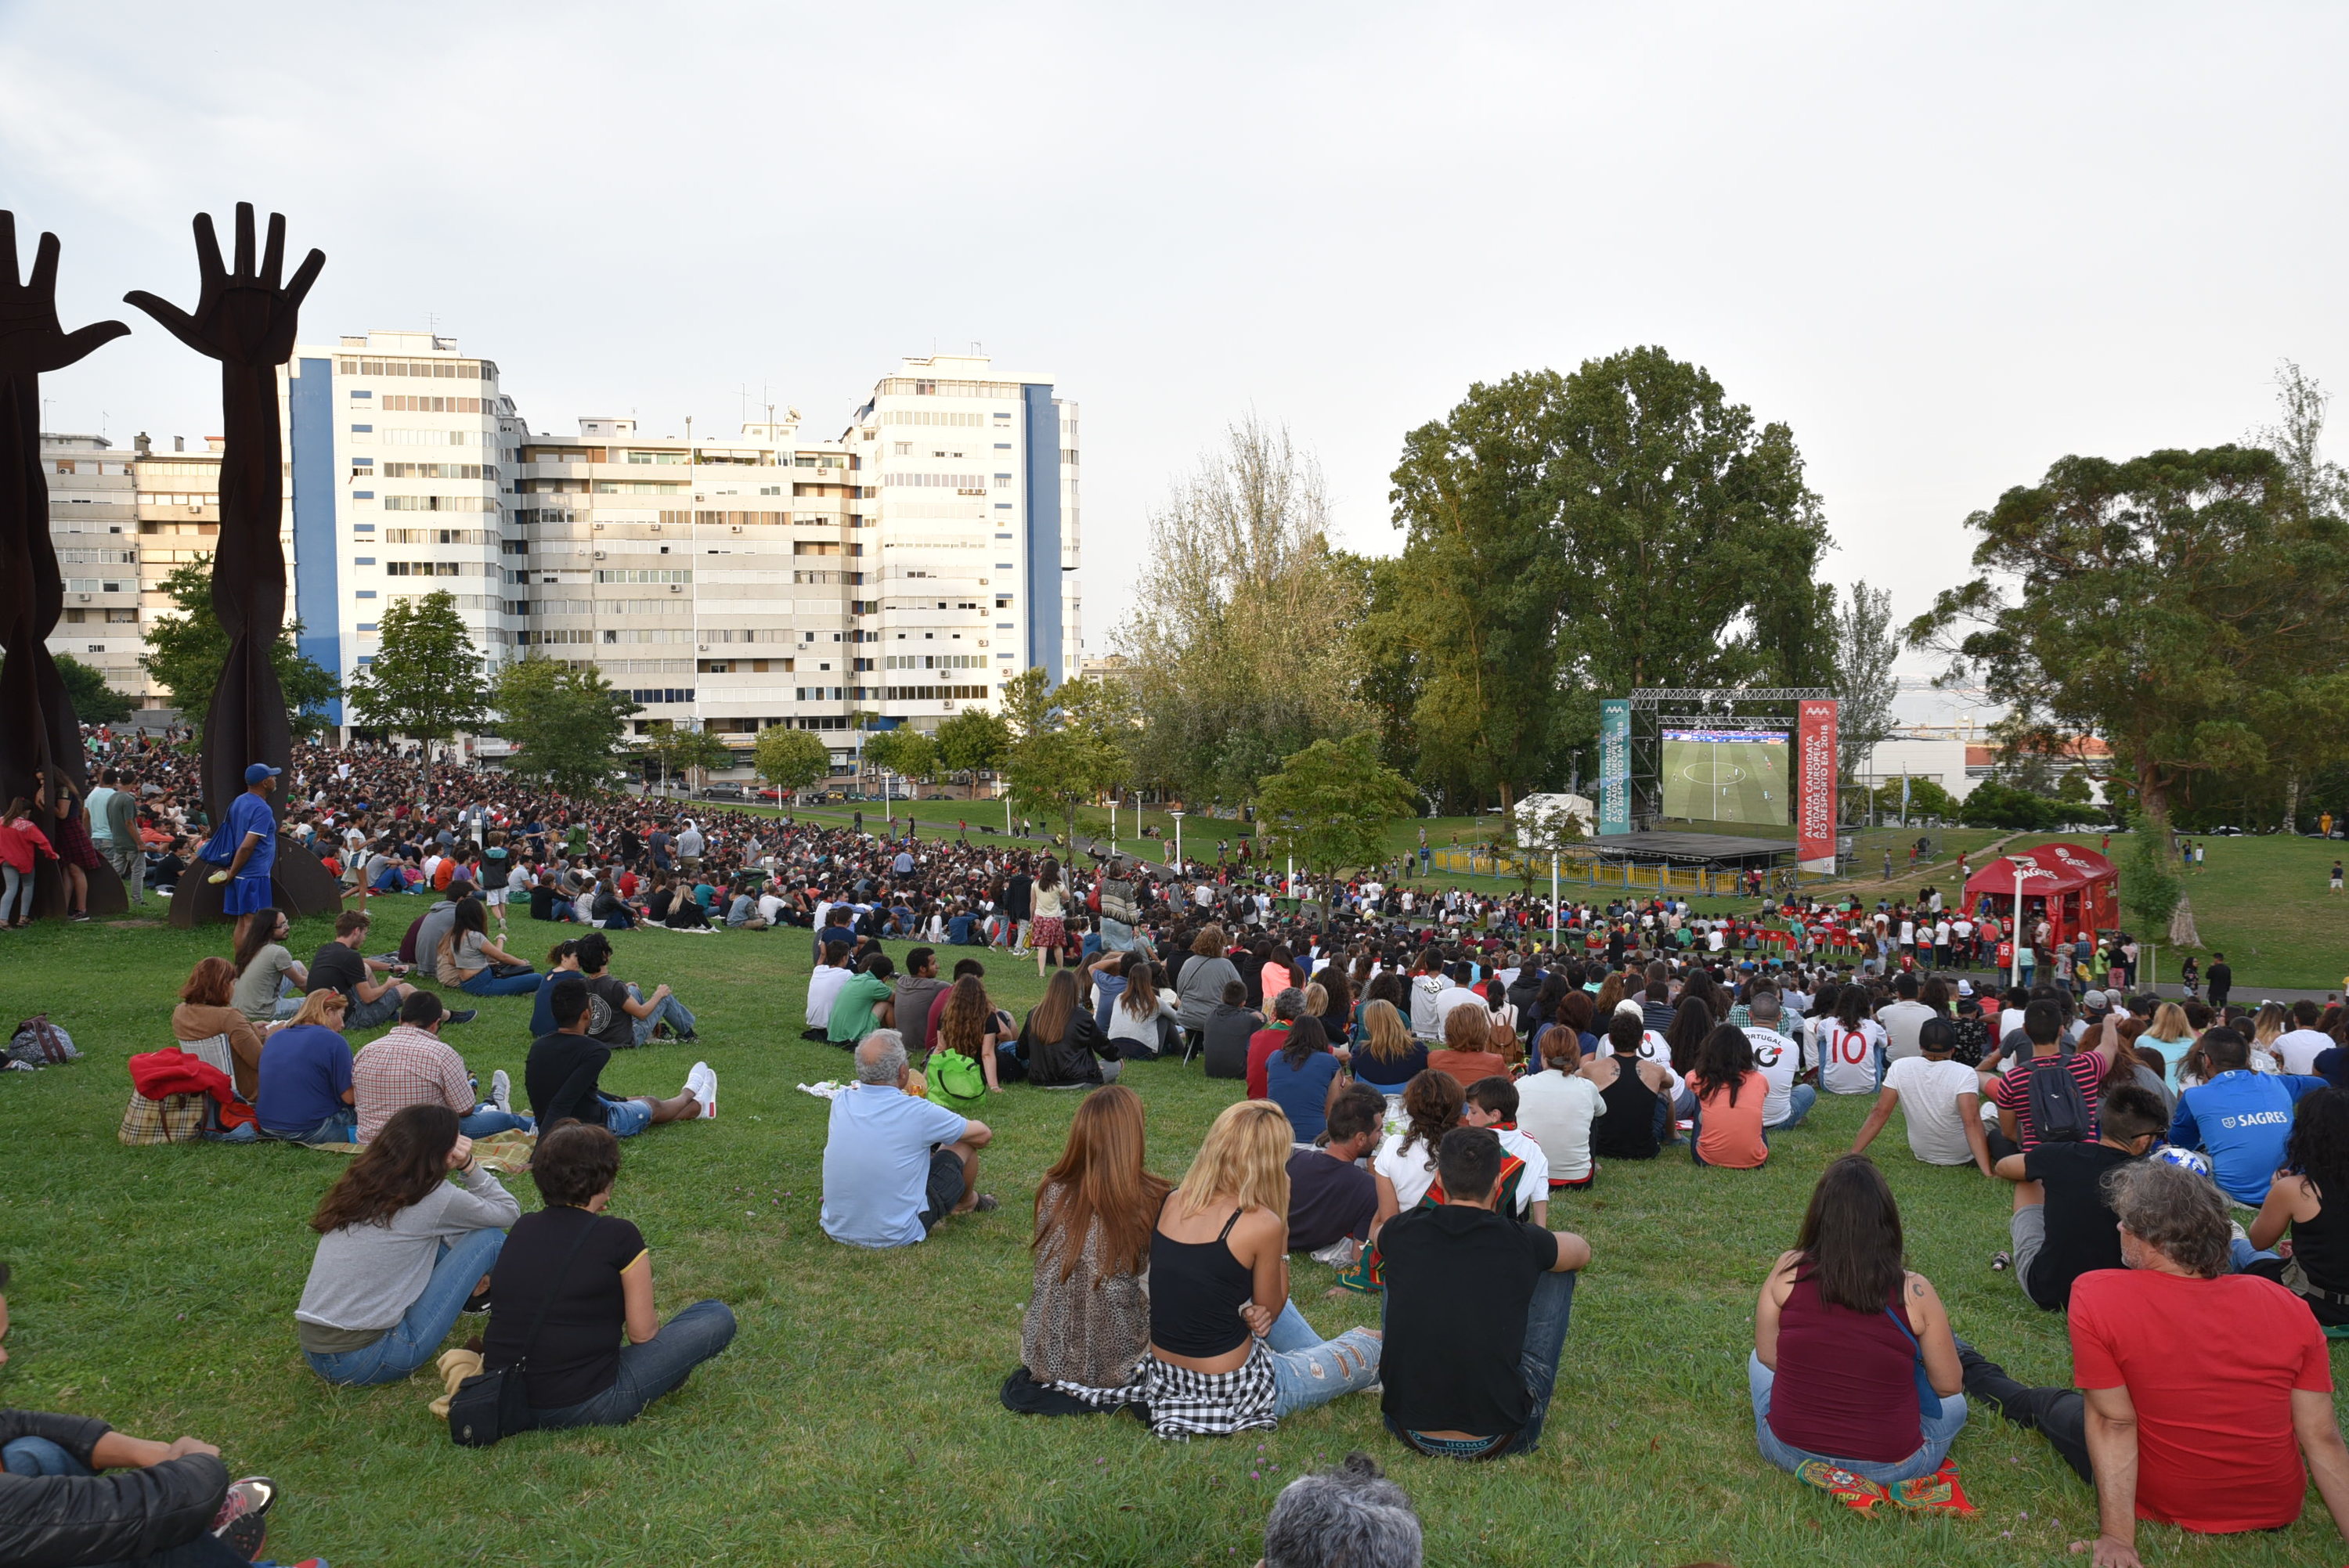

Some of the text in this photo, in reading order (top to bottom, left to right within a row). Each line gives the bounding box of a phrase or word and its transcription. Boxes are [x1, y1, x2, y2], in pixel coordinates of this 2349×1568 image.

[1617, 744, 1623, 758] EM
[1820, 751, 1828, 765] EM
[1618, 808, 1623, 823] DO
[1820, 823, 1828, 838] DO
[1745, 1033, 1782, 1046] ORTUGAL
[1831, 1029, 1867, 1065] 10
[2238, 1111, 2288, 1127] SAGRES
